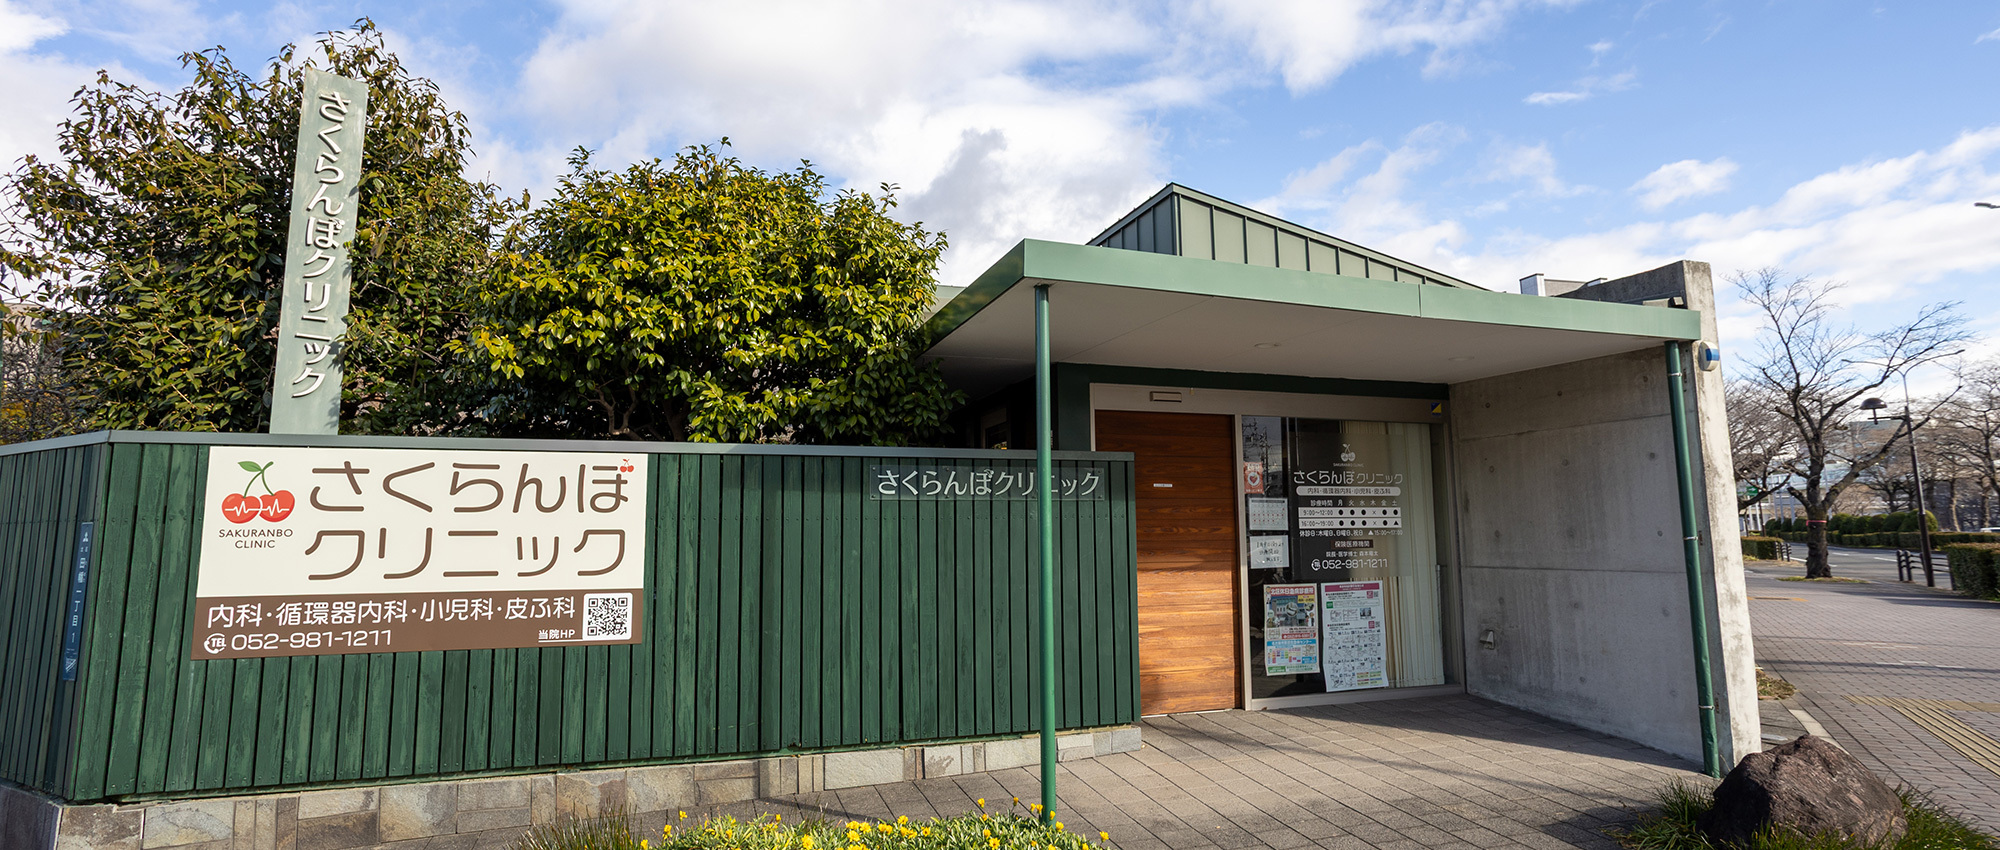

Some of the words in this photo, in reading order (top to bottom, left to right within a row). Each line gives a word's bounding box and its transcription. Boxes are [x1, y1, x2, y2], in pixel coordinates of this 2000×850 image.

[292, 91, 351, 398] さくらんぼクリニック
[310, 459, 634, 513] さくらんぼ
[1338, 499, 1343, 507] 月
[219, 529, 293, 538] SAKURANBO
[235, 540, 276, 549] CLINIC
[305, 527, 625, 581] クリニック
[1322, 559, 1388, 569] 052-981-1211
[207, 596, 575, 628] 内科・循環器内科・小児科・皮ふ科
[231, 630, 392, 651] 052-981-1211
[538, 629, 575, 640] 当院HP
